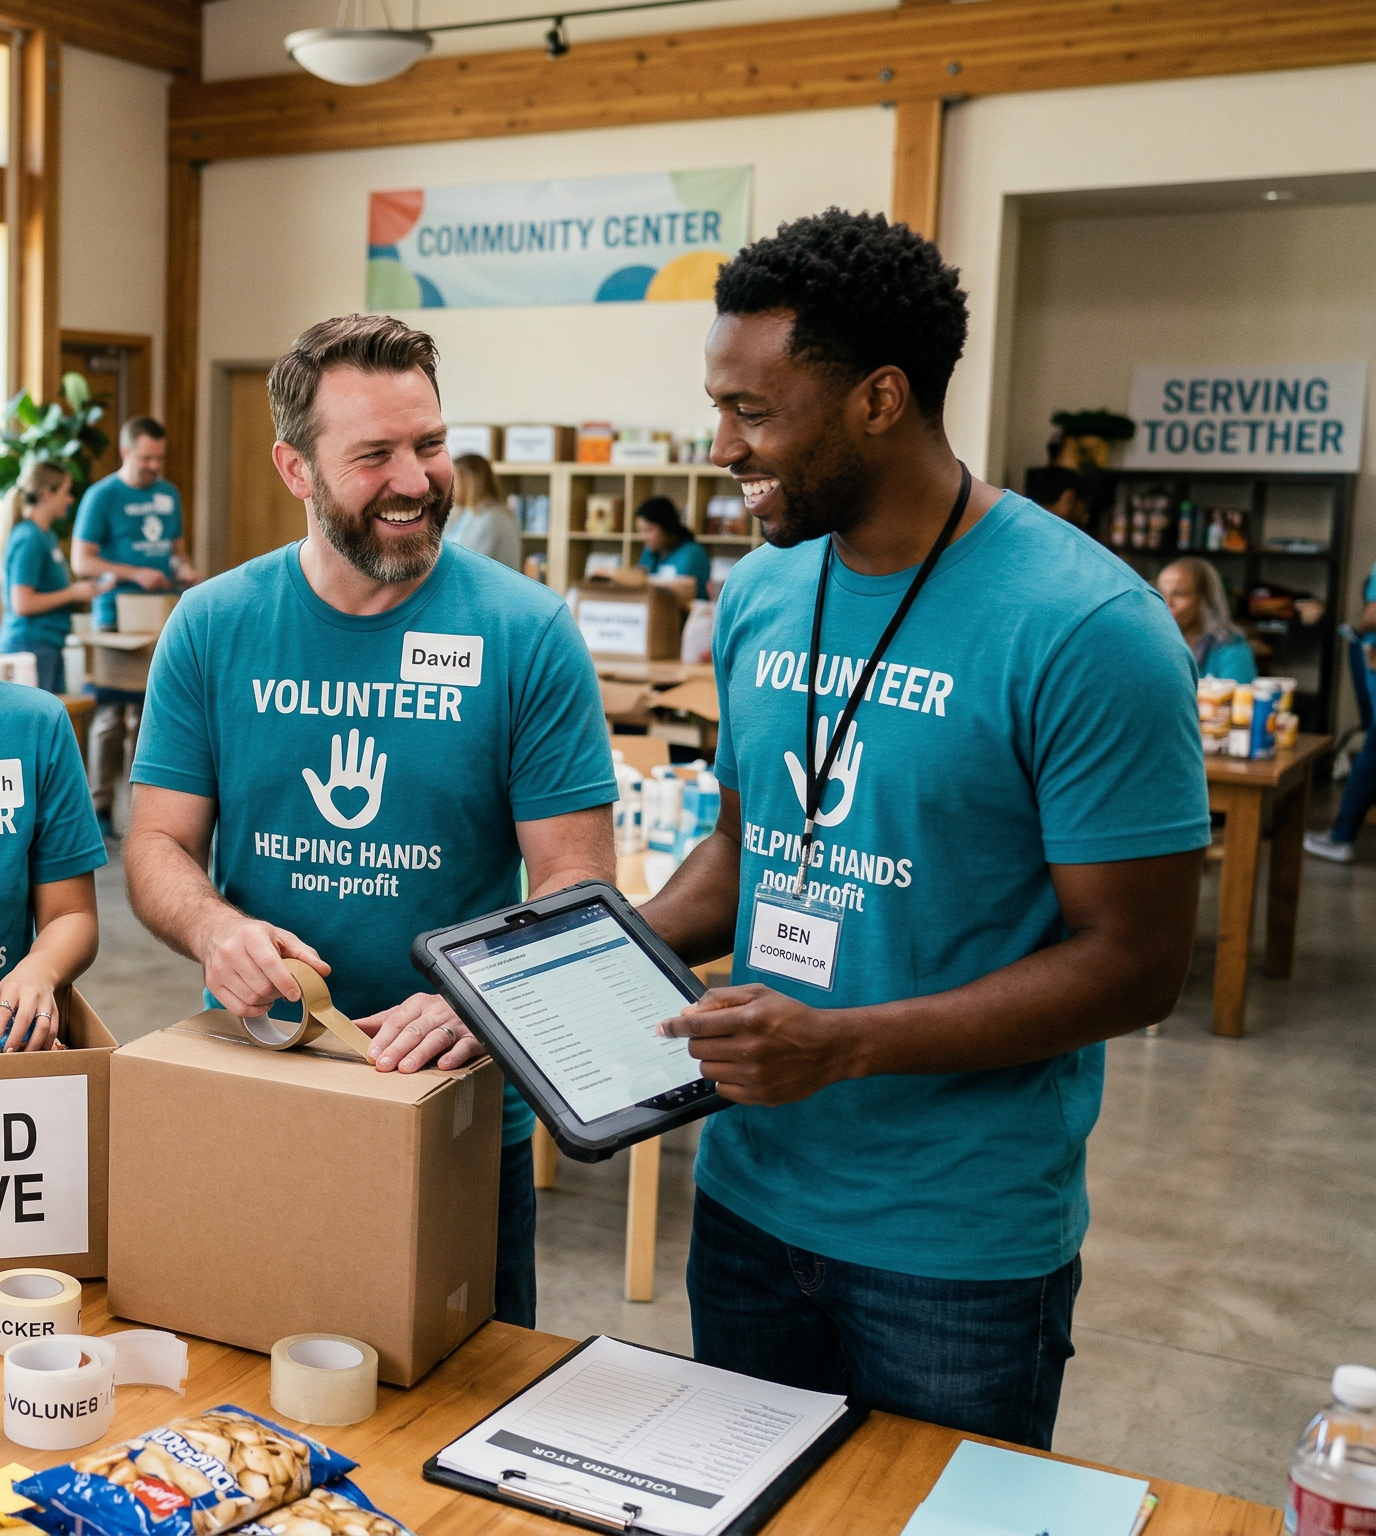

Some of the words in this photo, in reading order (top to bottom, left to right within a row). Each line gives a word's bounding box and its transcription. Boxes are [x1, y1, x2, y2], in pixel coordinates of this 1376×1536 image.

[417, 217, 595, 257] COMMUNITY
[603, 210, 721, 248] CENTER
[1162, 378, 1330, 414] SERVING
[1143, 420, 1345, 455] TOGETHER
[412, 648, 471, 668] David
[252, 678, 462, 721] VOLUNTEER
[755, 649, 954, 717] VOLUNTEER
[254, 832, 352, 866] HELPING
[359, 842, 442, 870] HANDS
[744, 822, 825, 868] HELPING
[829, 844, 913, 888] HANDS
[291, 872, 399, 899] non-profit
[777, 923, 811, 945] BEN
